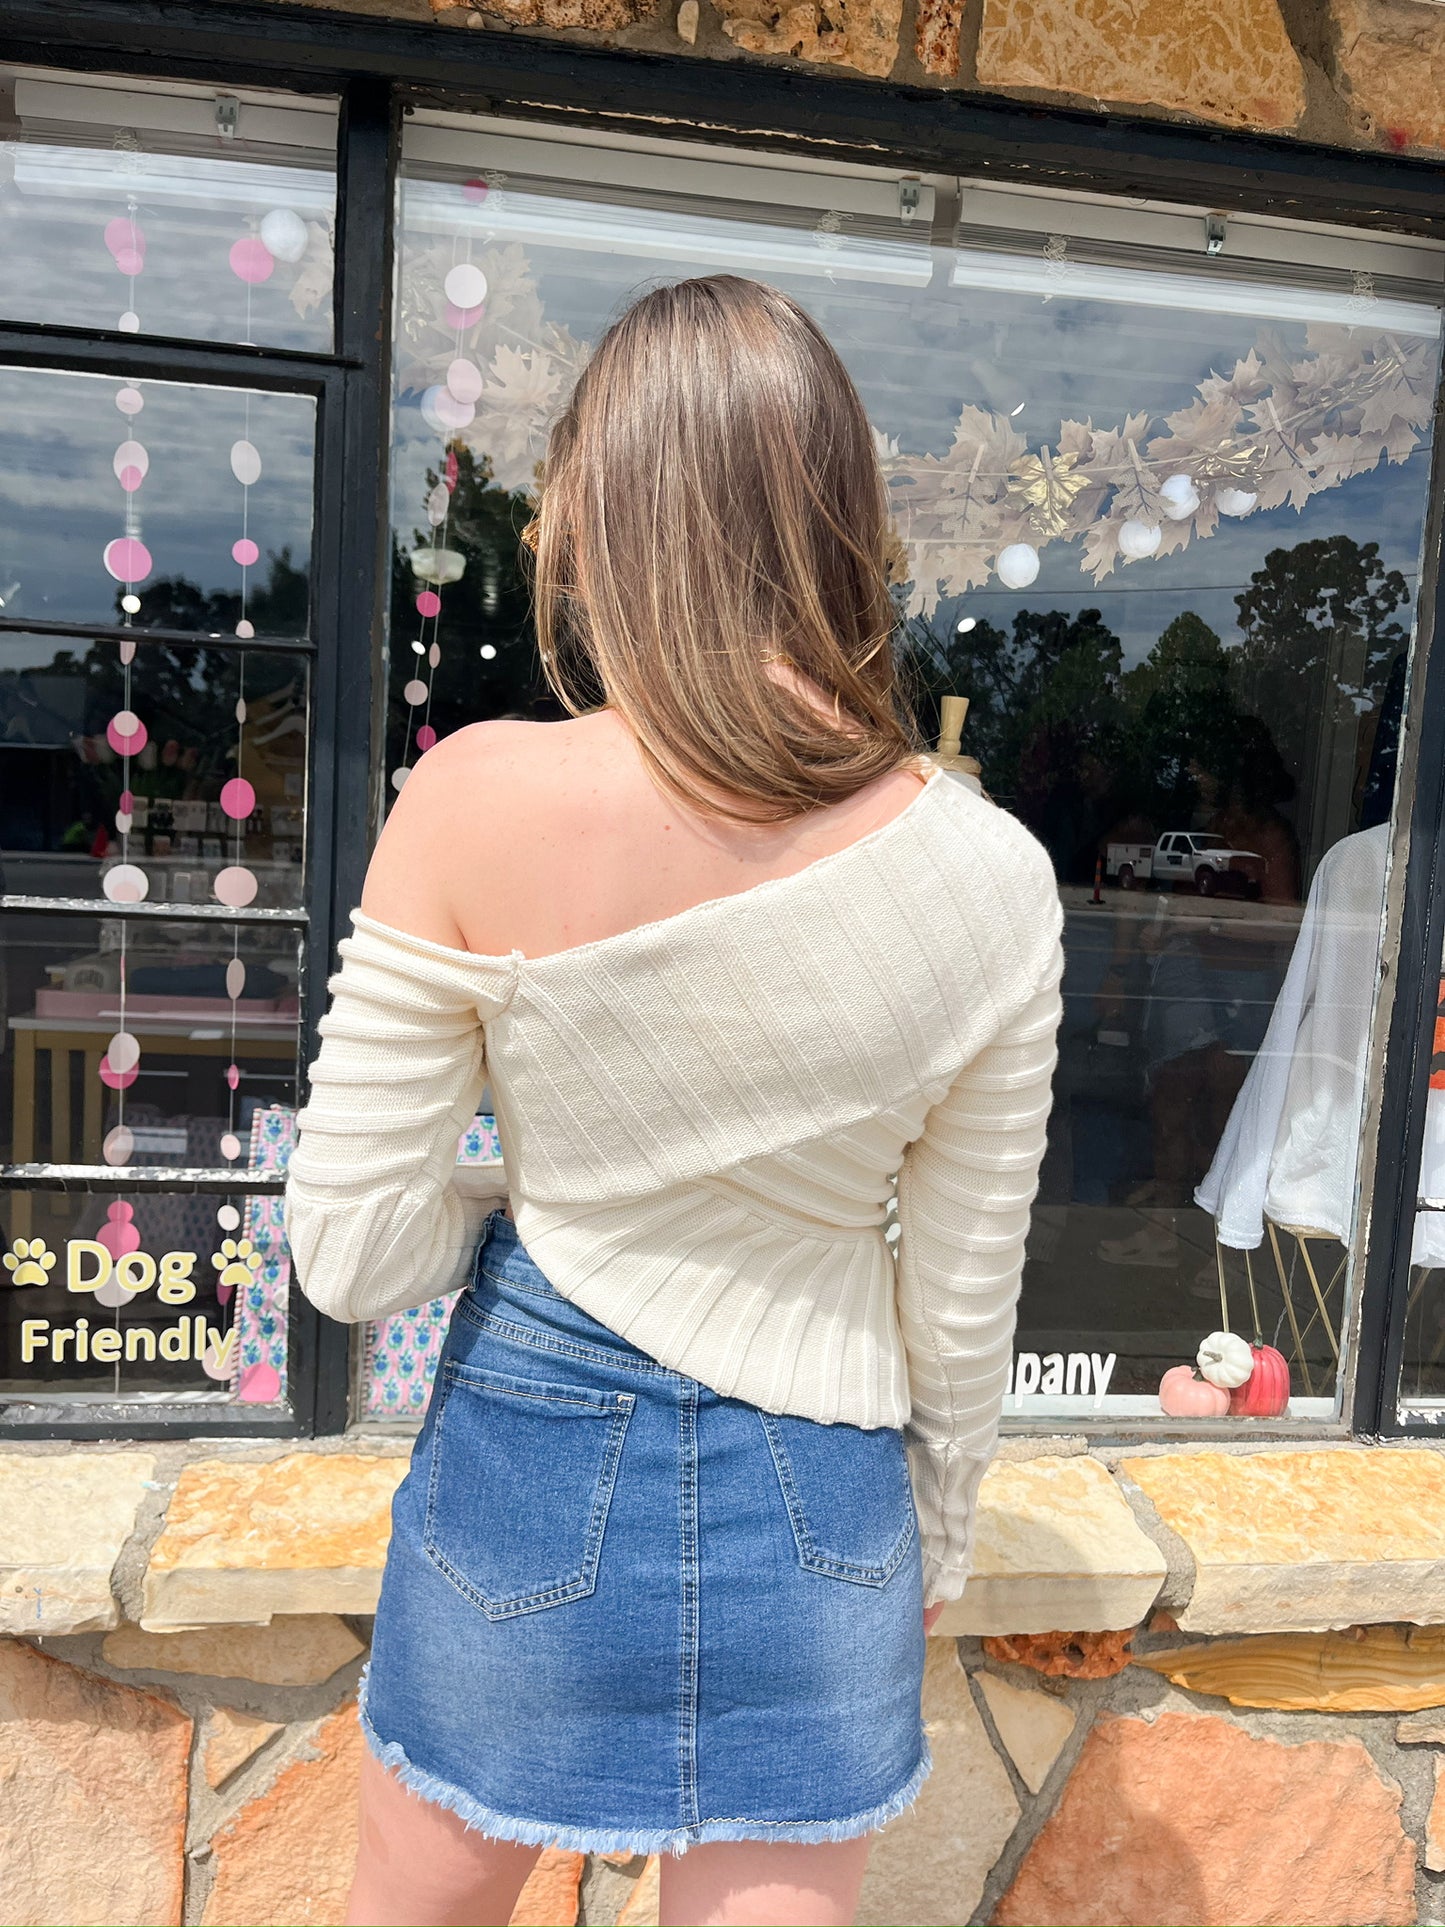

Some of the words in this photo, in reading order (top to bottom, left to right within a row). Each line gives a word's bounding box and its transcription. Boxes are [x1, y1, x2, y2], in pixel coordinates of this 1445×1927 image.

[66, 1239, 198, 1305] Dog
[21, 1315, 239, 1370] Friendly
[1004, 1352, 1117, 1409] pany
